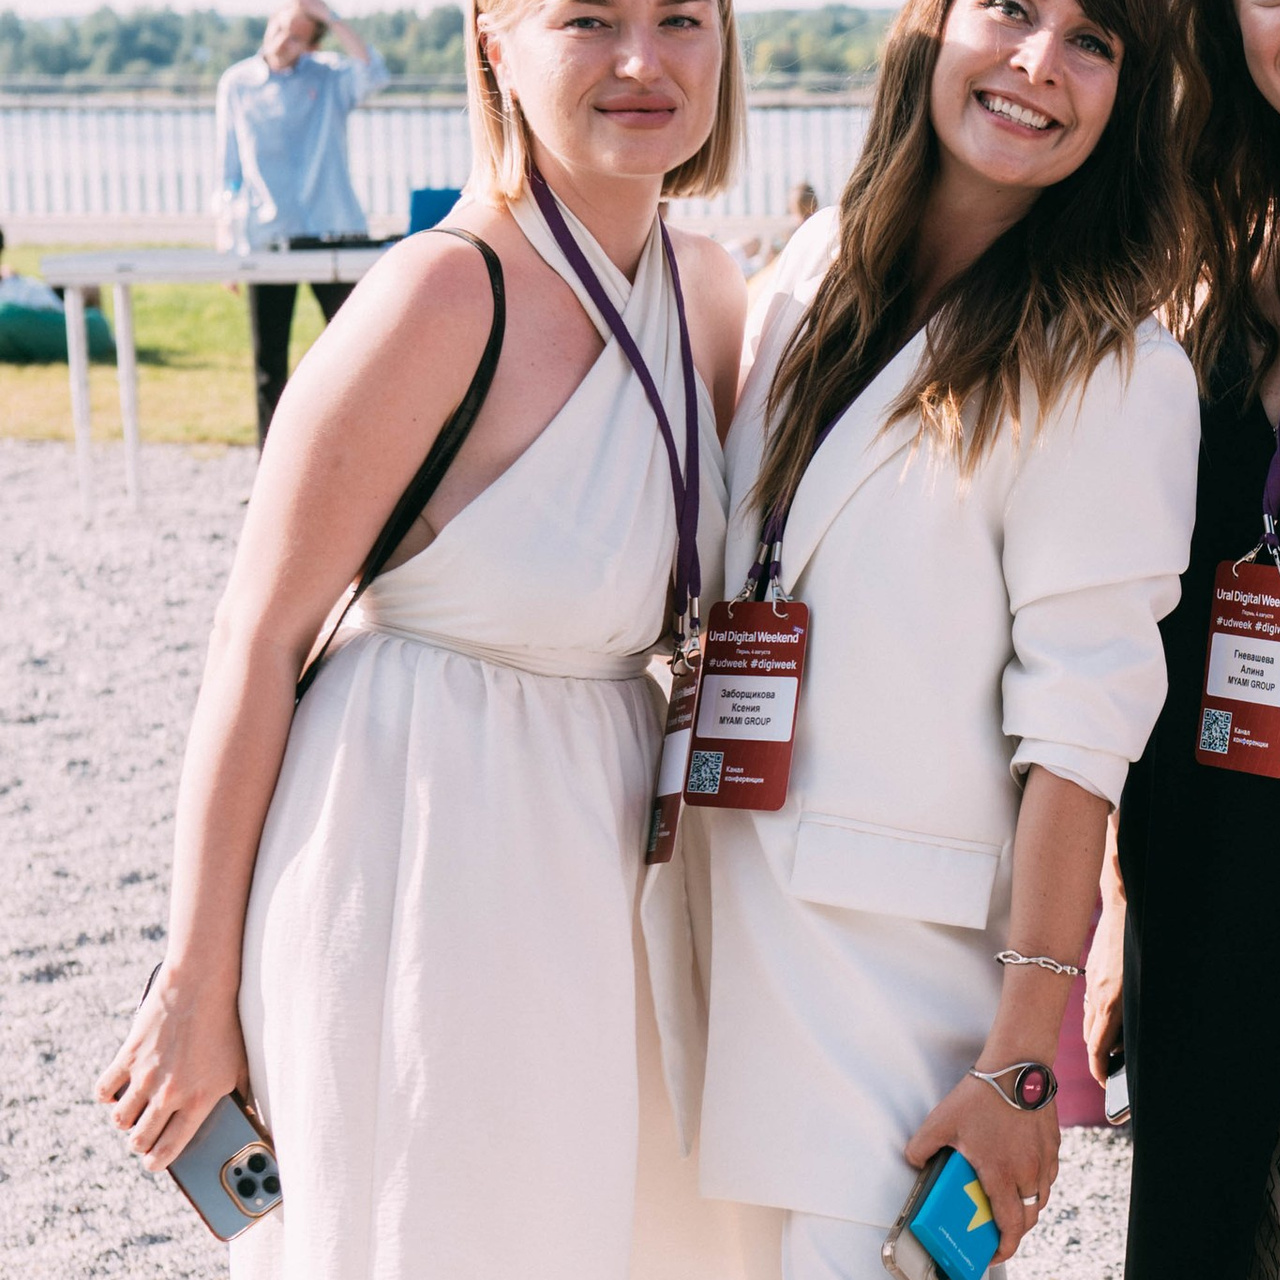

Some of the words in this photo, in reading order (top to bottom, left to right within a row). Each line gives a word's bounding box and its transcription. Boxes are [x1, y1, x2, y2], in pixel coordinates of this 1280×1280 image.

[1216, 588, 1234, 600] Ural
[1234, 590, 1261, 606] Digital
[1216, 616, 1253, 630] #udweek
[709, 630, 727, 642] Ural
[727, 630, 756, 645] Digital
[757, 631, 799, 643] Weekend
[1233, 649, 1275, 664] Гневашева
[709, 658, 748, 668] #udweek
[750, 658, 797, 672] #digiweek
[1240, 664, 1265, 677] Алина
[1227, 675, 1250, 687] MYAMI
[1250, 680, 1276, 691] GROUP
[720, 689, 776, 700] Заборщикова
[731, 703, 761, 713] Ксения
[719, 716, 743, 725] MYAMI
[744, 716, 772, 726] GROUP
